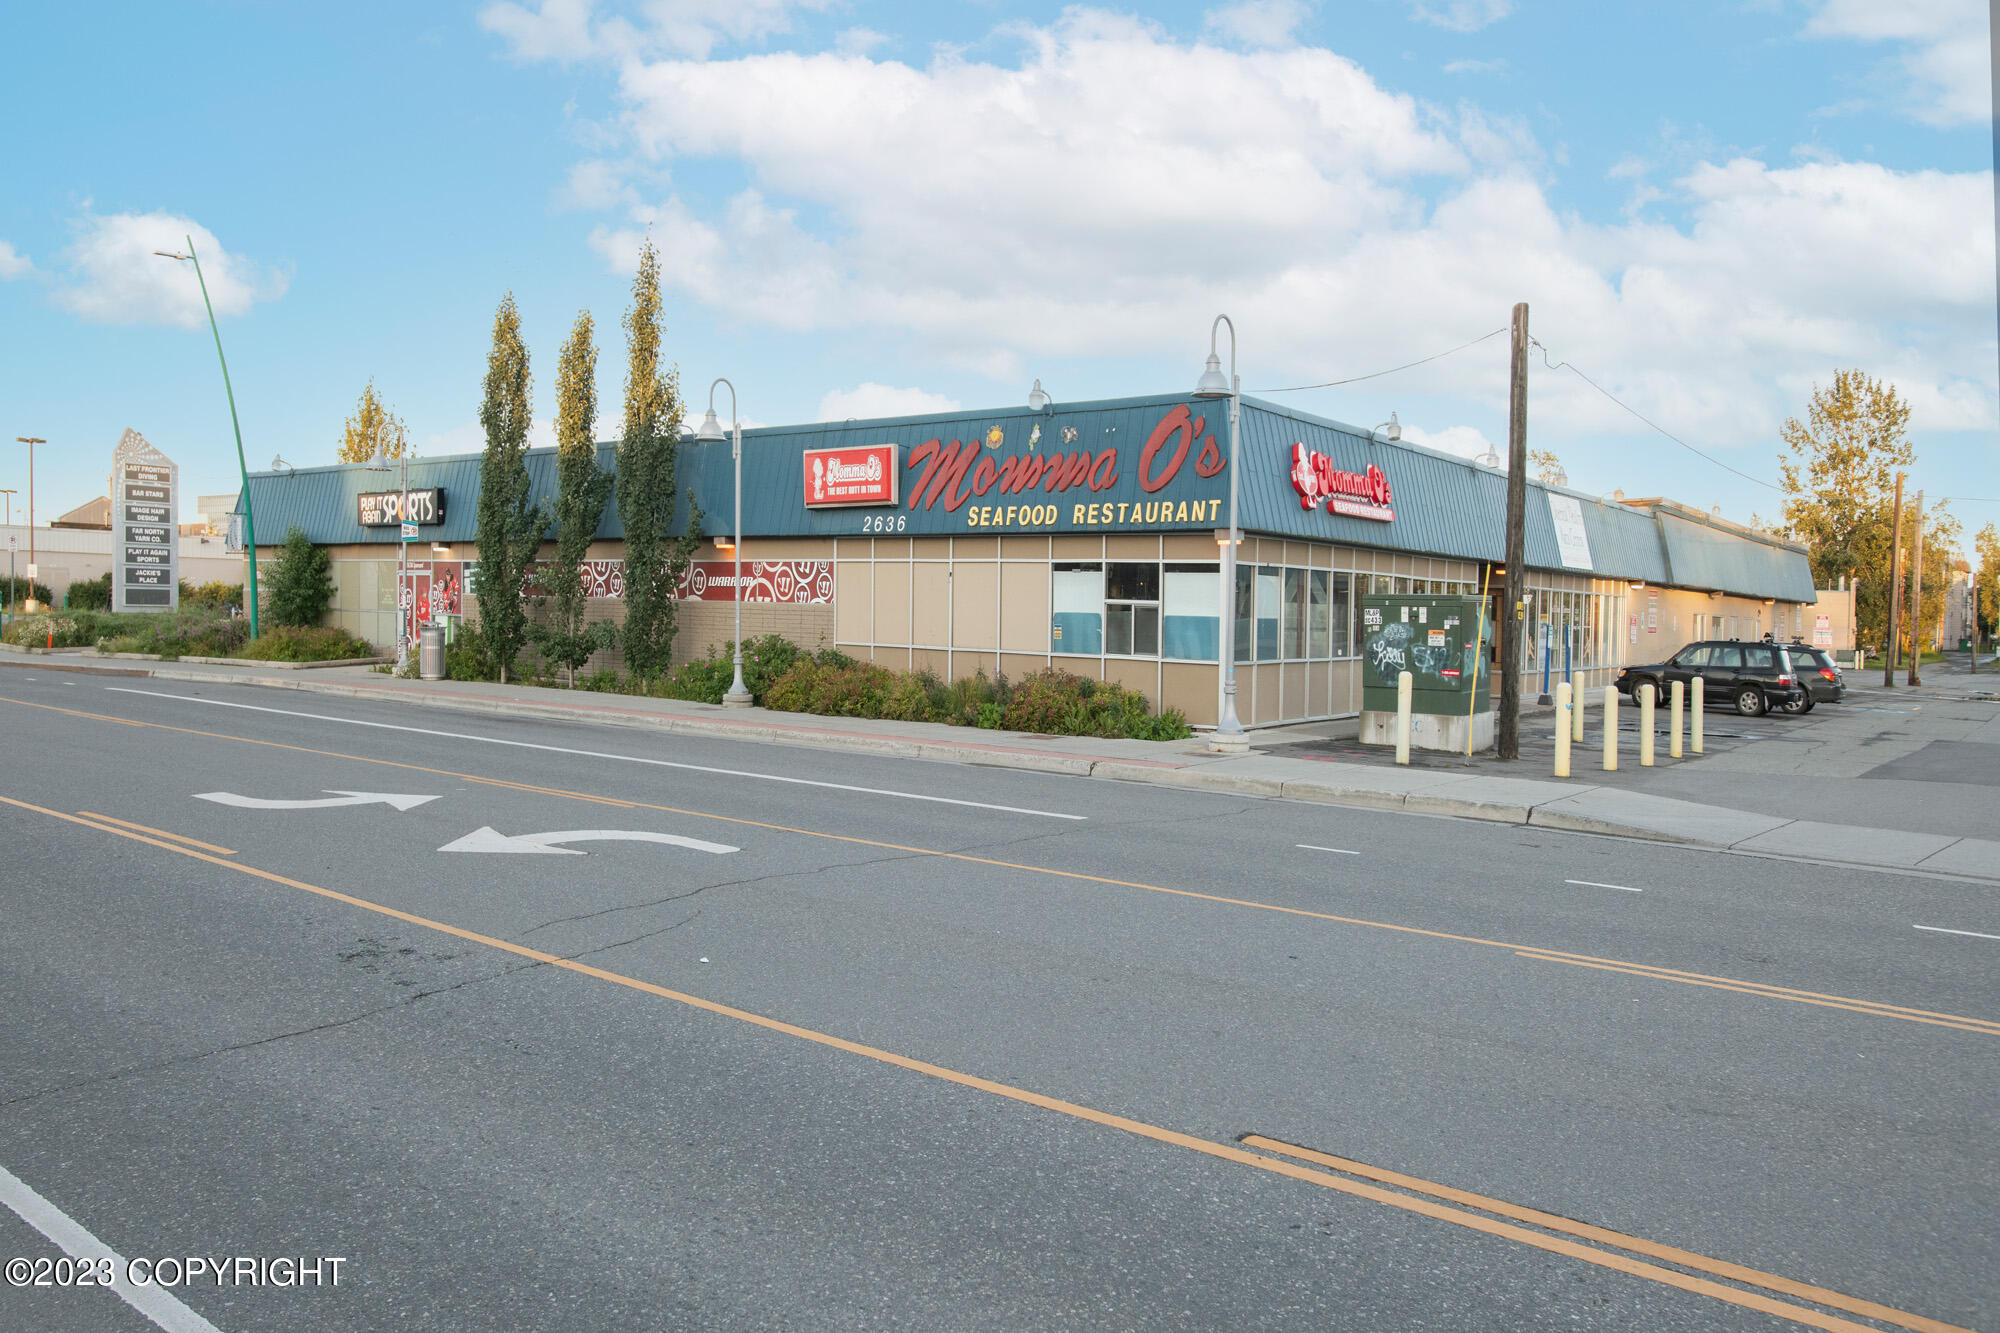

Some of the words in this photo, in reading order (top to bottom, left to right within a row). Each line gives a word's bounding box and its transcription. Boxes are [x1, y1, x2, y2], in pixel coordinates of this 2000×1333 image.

[908, 438, 1118, 512] Momma
[1139, 404, 1227, 493] O's
[126, 464, 142, 472] LAST
[142, 465, 169, 474] FRONTIER
[827, 457, 867, 486] Momma
[867, 453, 882, 481] O's
[1315, 451, 1373, 497] Momma
[145, 490, 164, 498] STARS
[828, 487, 836, 496] THE
[131, 506, 150, 514] IMAGE
[361, 497, 376, 511] PLAY
[376, 496, 383, 510] IT
[382, 491, 433, 523] SPORTS
[362, 510, 381, 524] AGAIN
[967, 504, 1058, 527] SEAFOOD
[1072, 499, 1222, 525] RESTAURANT
[862, 515, 906, 532] 2636
[708, 576, 754, 587] WARROR
